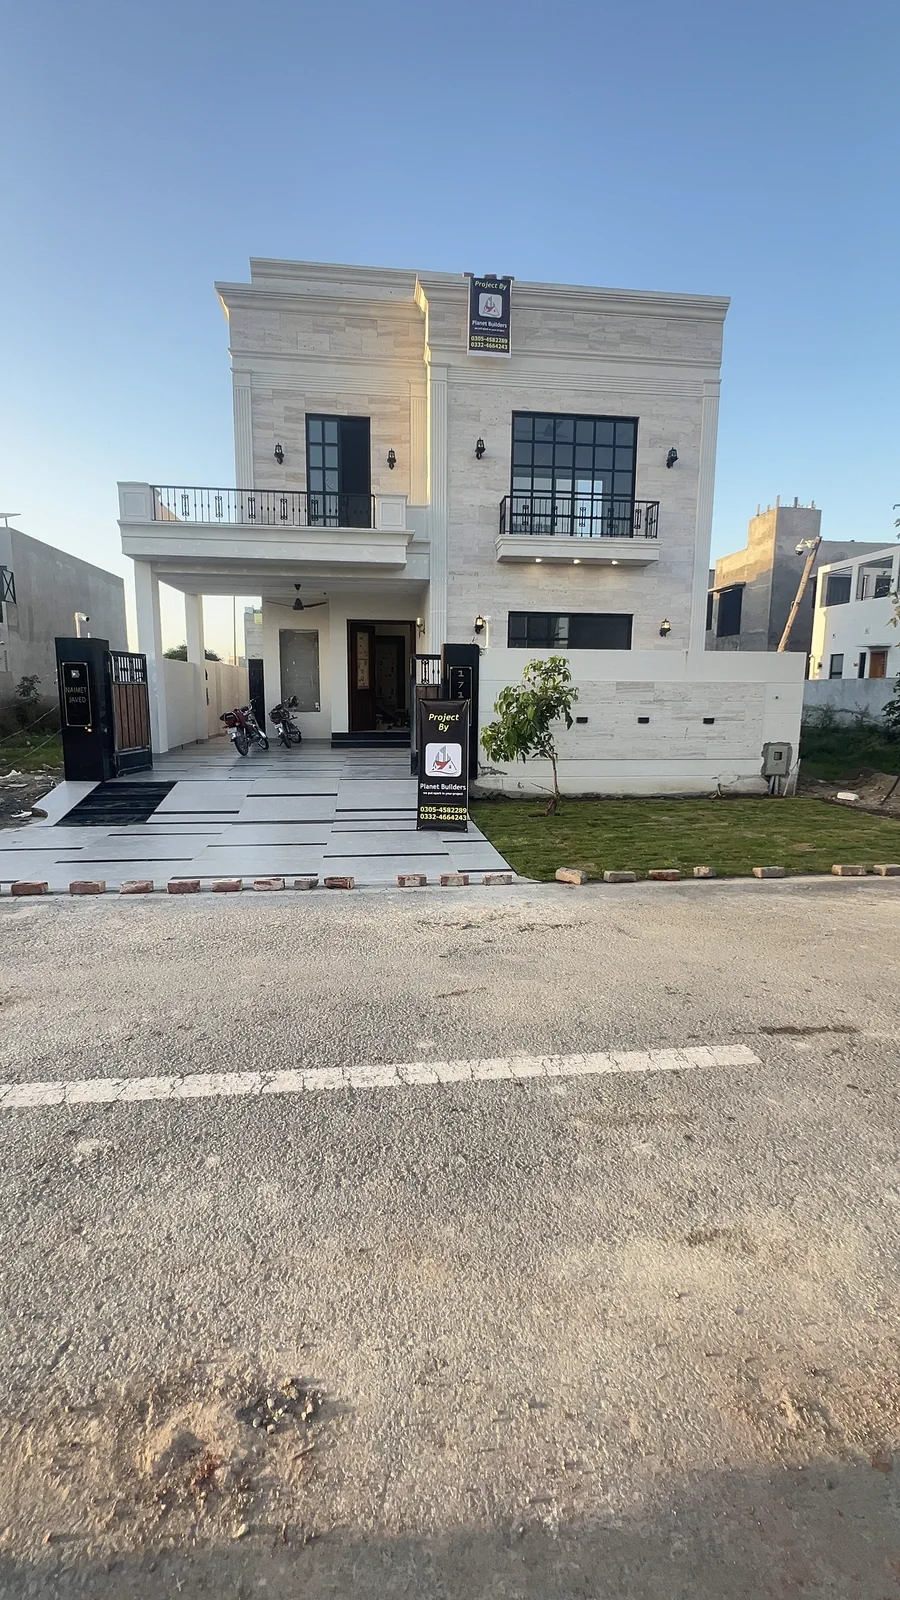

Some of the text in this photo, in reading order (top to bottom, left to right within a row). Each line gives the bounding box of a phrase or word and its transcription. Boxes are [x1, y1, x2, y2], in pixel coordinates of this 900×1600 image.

[474, 280, 498, 289] Project
[428, 713, 460, 722] Project
[438, 723, 450, 732] By
[420, 782, 440, 790] Planet
[420, 806, 467, 814] 0305-4582289
[420, 813, 467, 821] 0332-4664243
